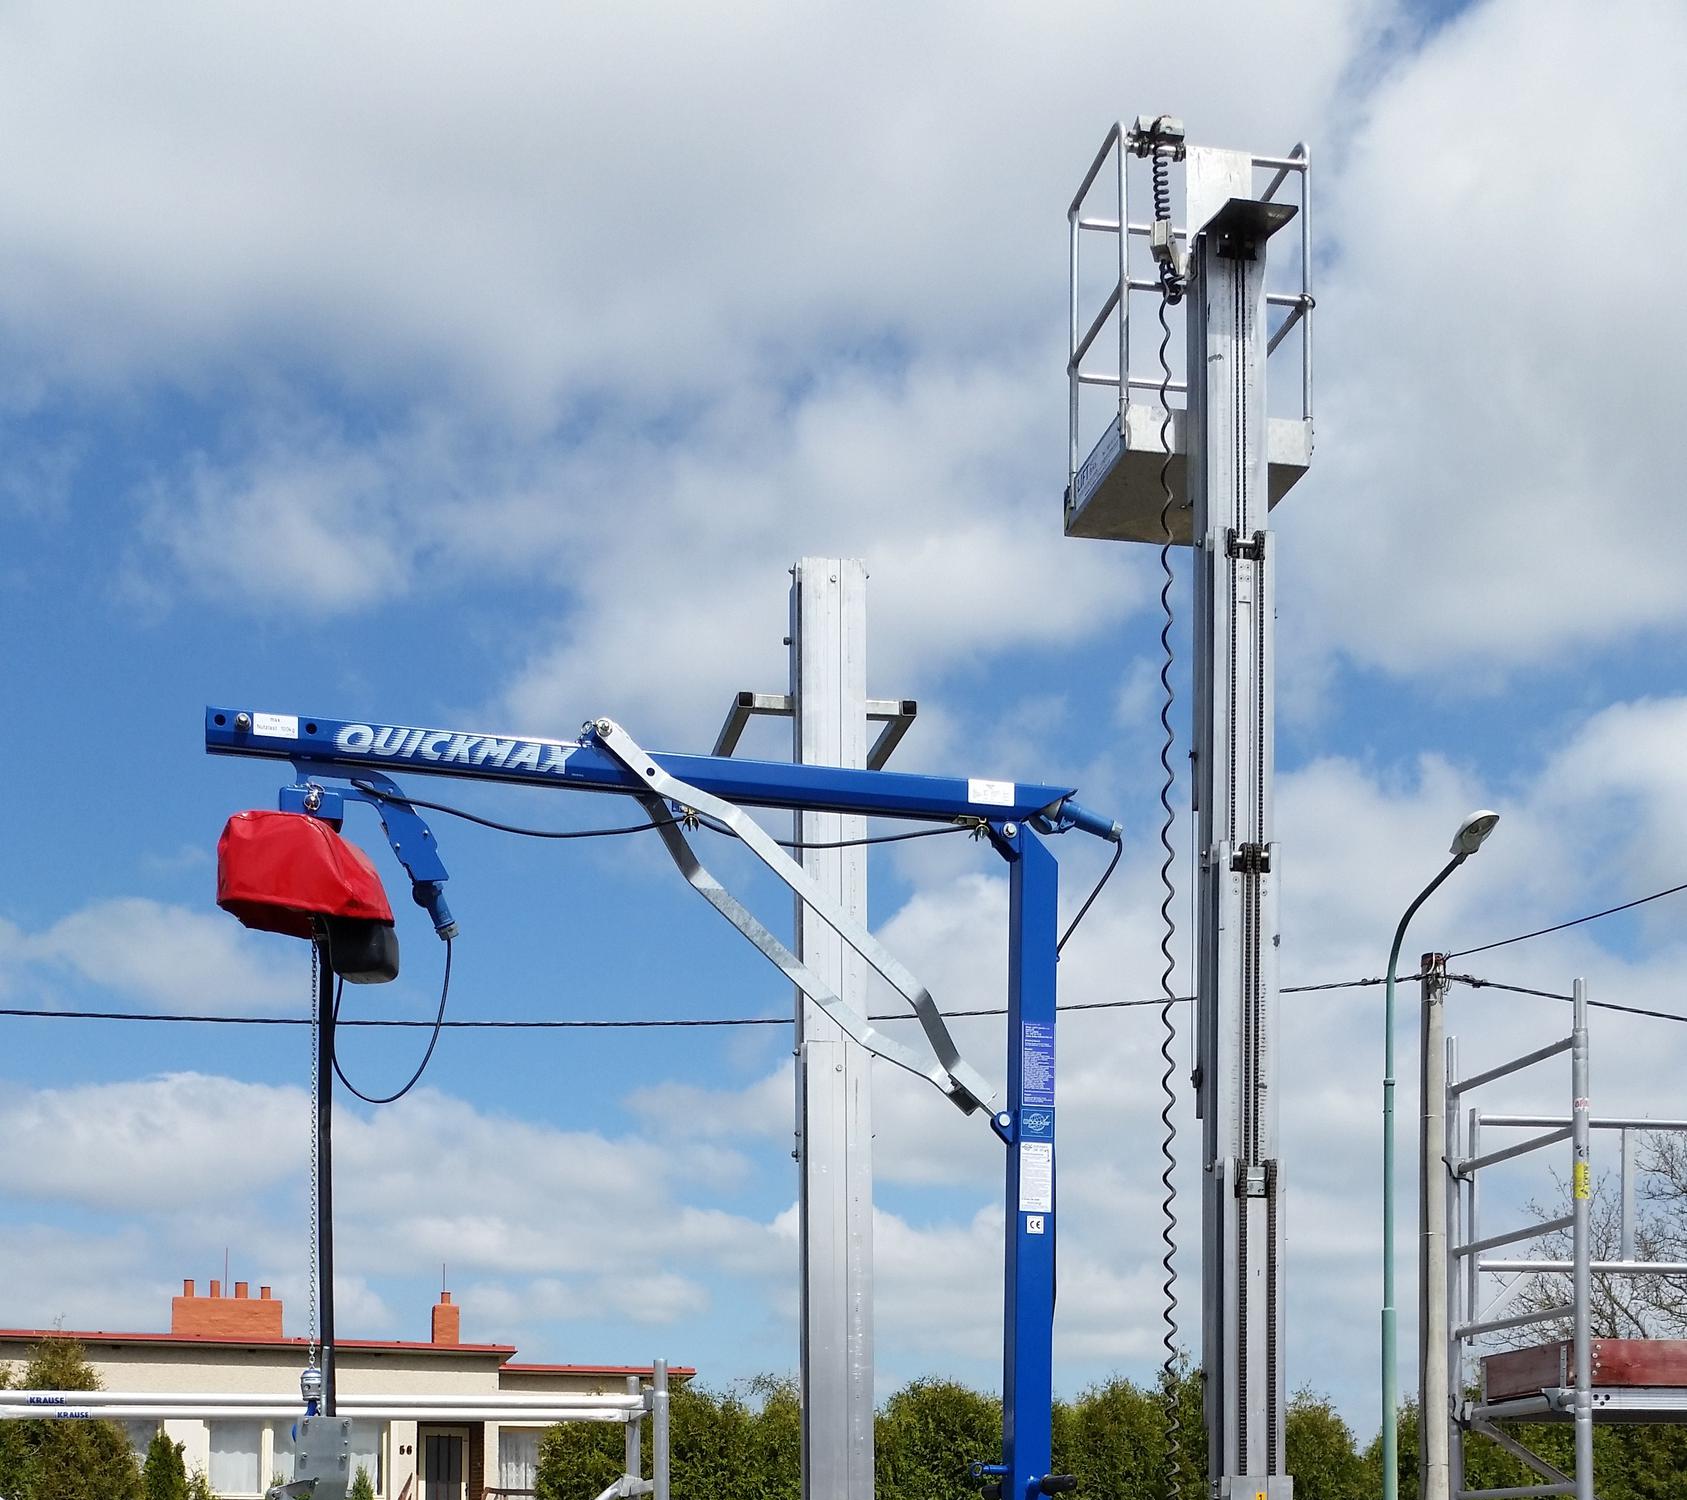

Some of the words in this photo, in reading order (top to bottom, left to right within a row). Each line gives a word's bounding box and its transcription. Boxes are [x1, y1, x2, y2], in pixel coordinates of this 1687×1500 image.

[334, 724, 578, 774] QUICKMAX
[29, 1396, 65, 1404] KRAUSE
[399, 1445, 412, 1455] 56
